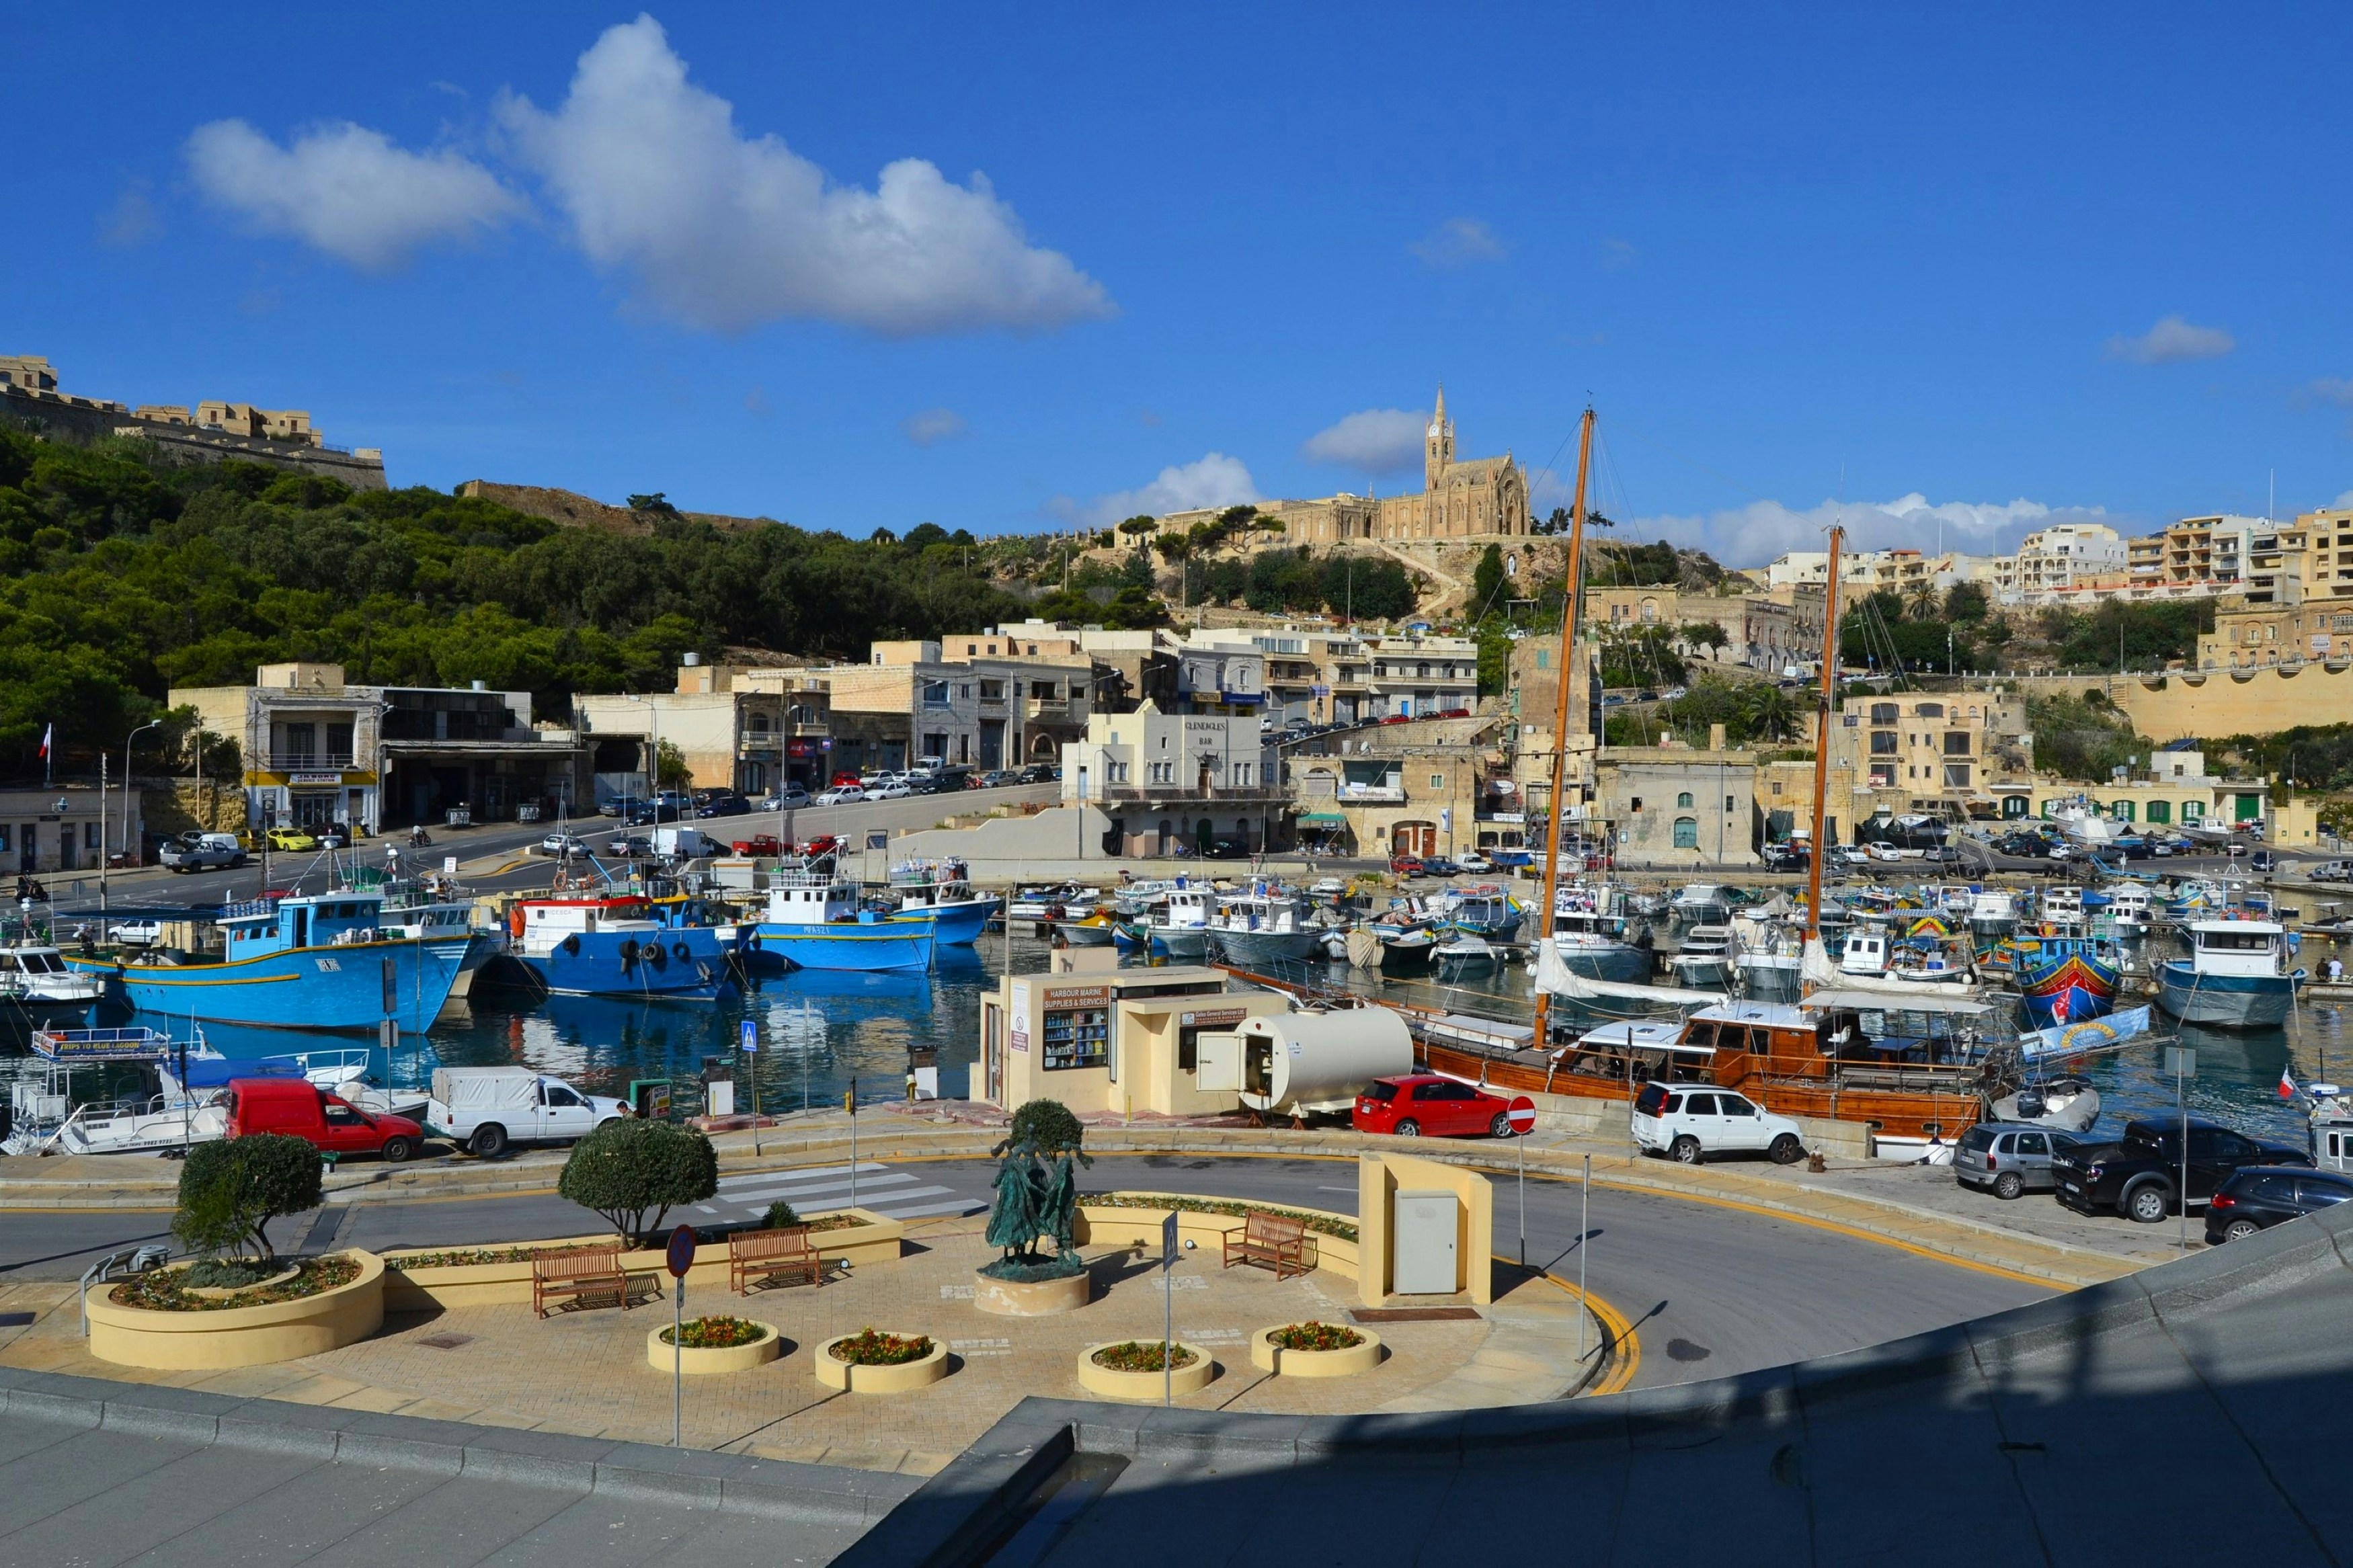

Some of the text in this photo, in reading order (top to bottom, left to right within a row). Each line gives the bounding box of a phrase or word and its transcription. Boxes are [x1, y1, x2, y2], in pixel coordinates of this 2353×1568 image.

[1185, 721, 1226, 731] GLENEAGLES
[1199, 737, 1212, 745] BAR
[1050, 988, 1103, 997] HARBOUR MARINE
[1045, 999, 1073, 1008] SUPPLIES
[1079, 997, 1108, 1006] SERVICES
